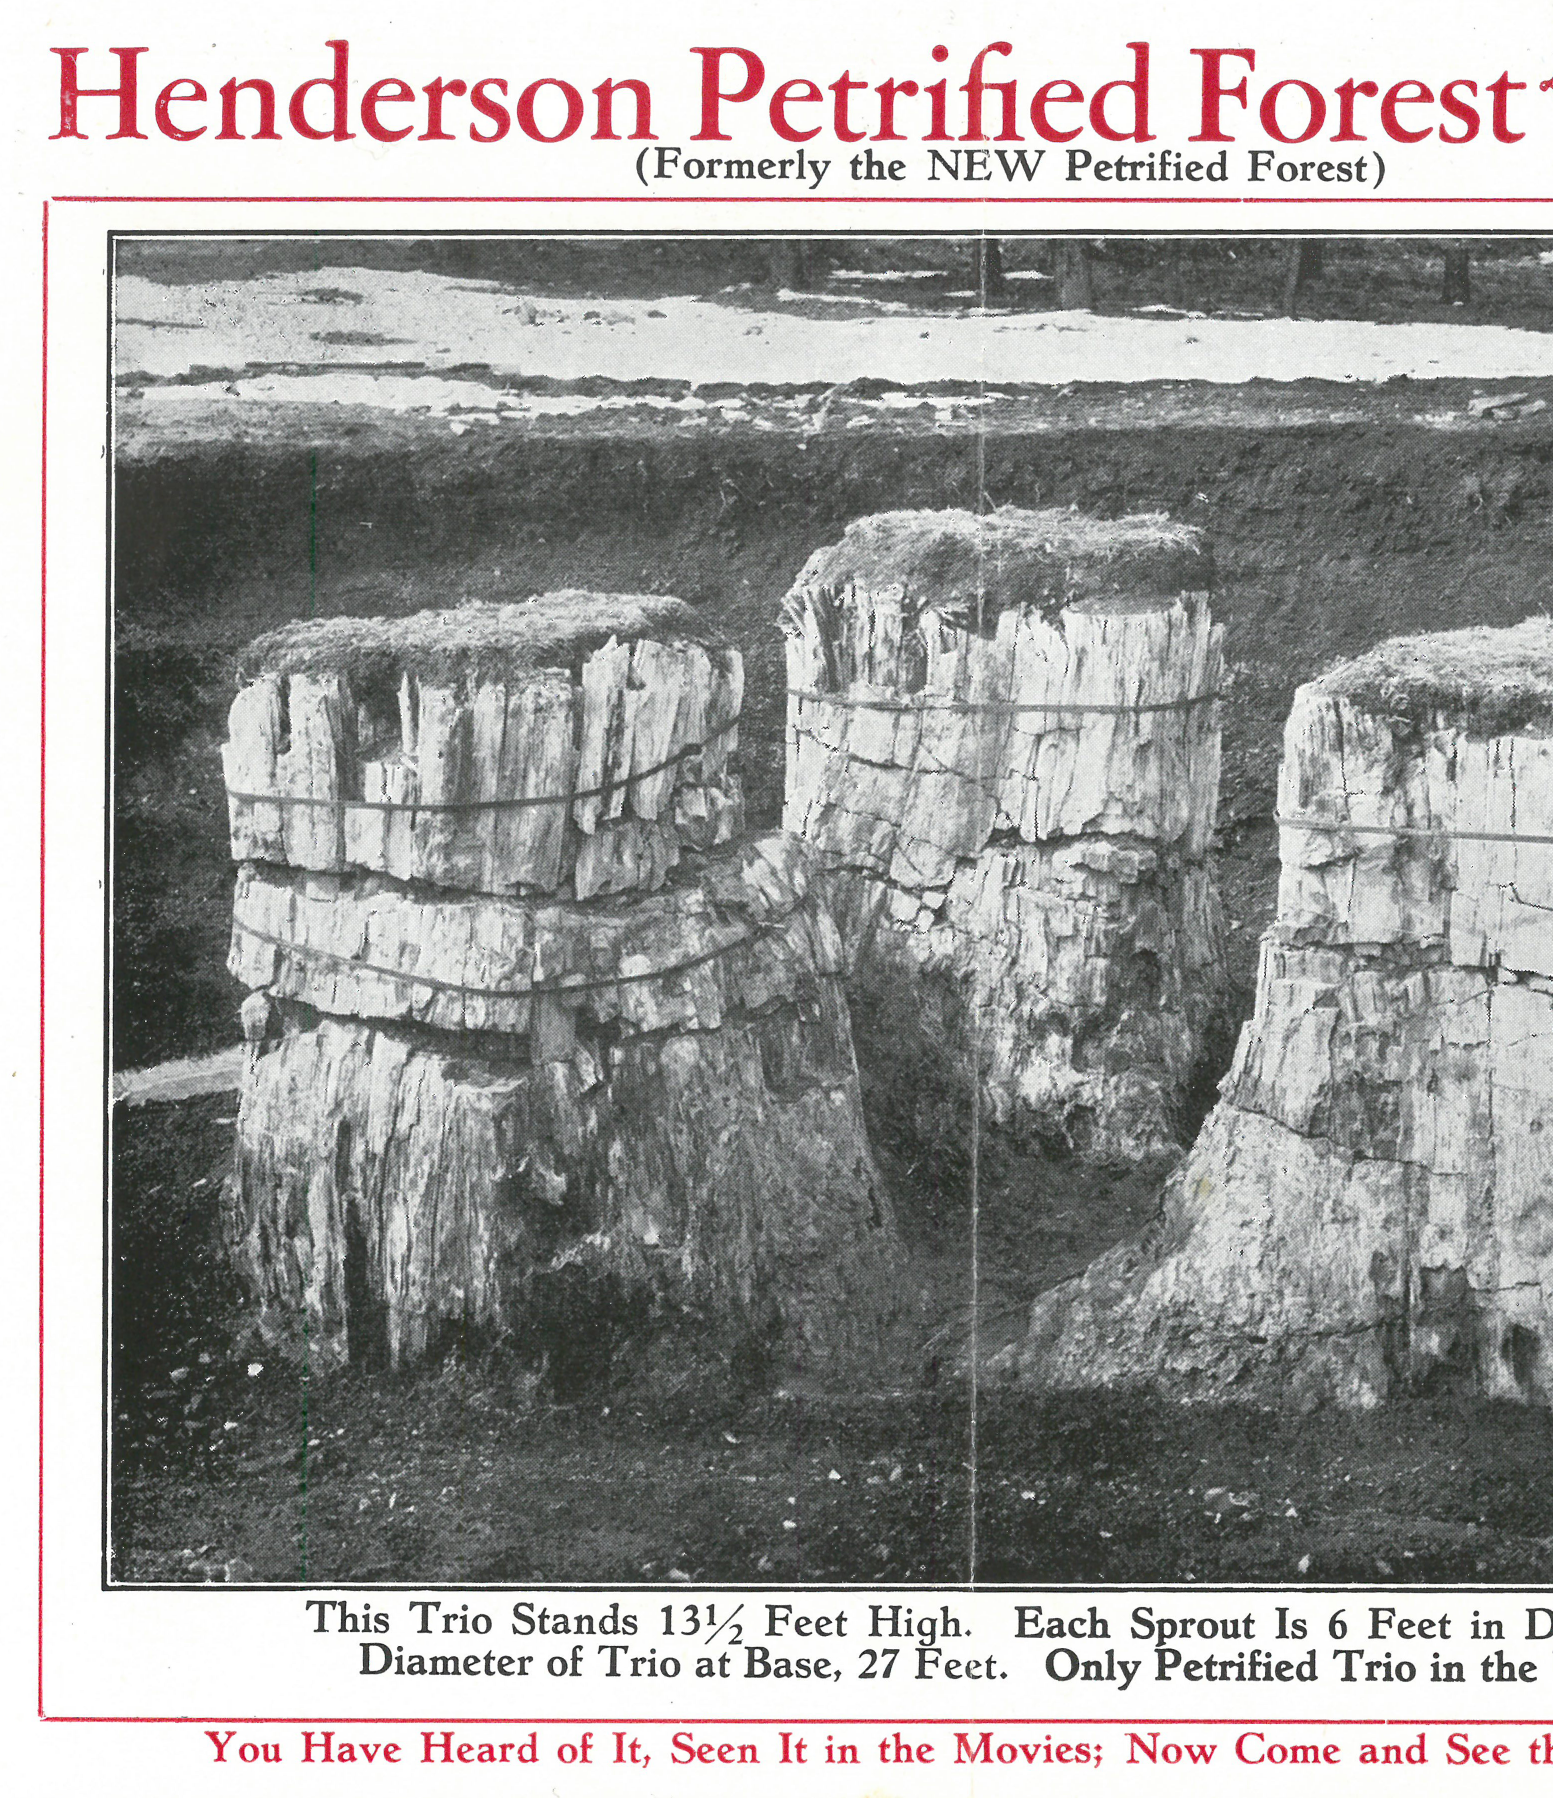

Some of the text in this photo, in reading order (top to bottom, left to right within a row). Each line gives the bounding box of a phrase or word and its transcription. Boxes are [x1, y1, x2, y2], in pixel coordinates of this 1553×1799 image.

[48, 40, 1528, 145] Henderson Petrified Forest
[636, 147, 1386, 190] (Formerly the NEW Petrified Forest)
[306, 1600, 974, 1647] This Trio Stands 13½ Feet High.
[1015, 1606, 1112, 1639] Each
[1130, 1607, 1256, 1646] Sprout
[1275, 1608, 1308, 1640] Is
[1328, 1609, 1348, 1640] 6
[1368, 1608, 1452, 1640] Feet
[1470, 1608, 1506, 1640] in
[360, 1642, 1009, 1683] Diameter of Trio at Base, 27 Feet.
[1045, 1647, 1142, 1690] Only
[1153, 1648, 1319, 1683] Petrified
[1333, 1649, 1417, 1683] Trio
[1430, 1651, 1466, 1683] in
[1481, 1649, 1538, 1684] the
[205, 1731, 282, 1763] You
[302, 1731, 402, 1764] Have
[421, 1731, 540, 1764] Heard
[558, 1731, 594, 1764] of
[612, 1731, 651, 1769] It,
[671, 1731, 761, 1765] Seen
[779, 1732, 808, 1764] It
[826, 1732, 861, 1764] in
[879, 1732, 935, 1764] the
[954, 1731, 1103, 1769] Movies;
[1125, 1732, 1218, 1765] Now
[1236, 1732, 1341, 1765] Come
[1360, 1732, 1429, 1765] and
[1446, 1732, 1511, 1766] See
